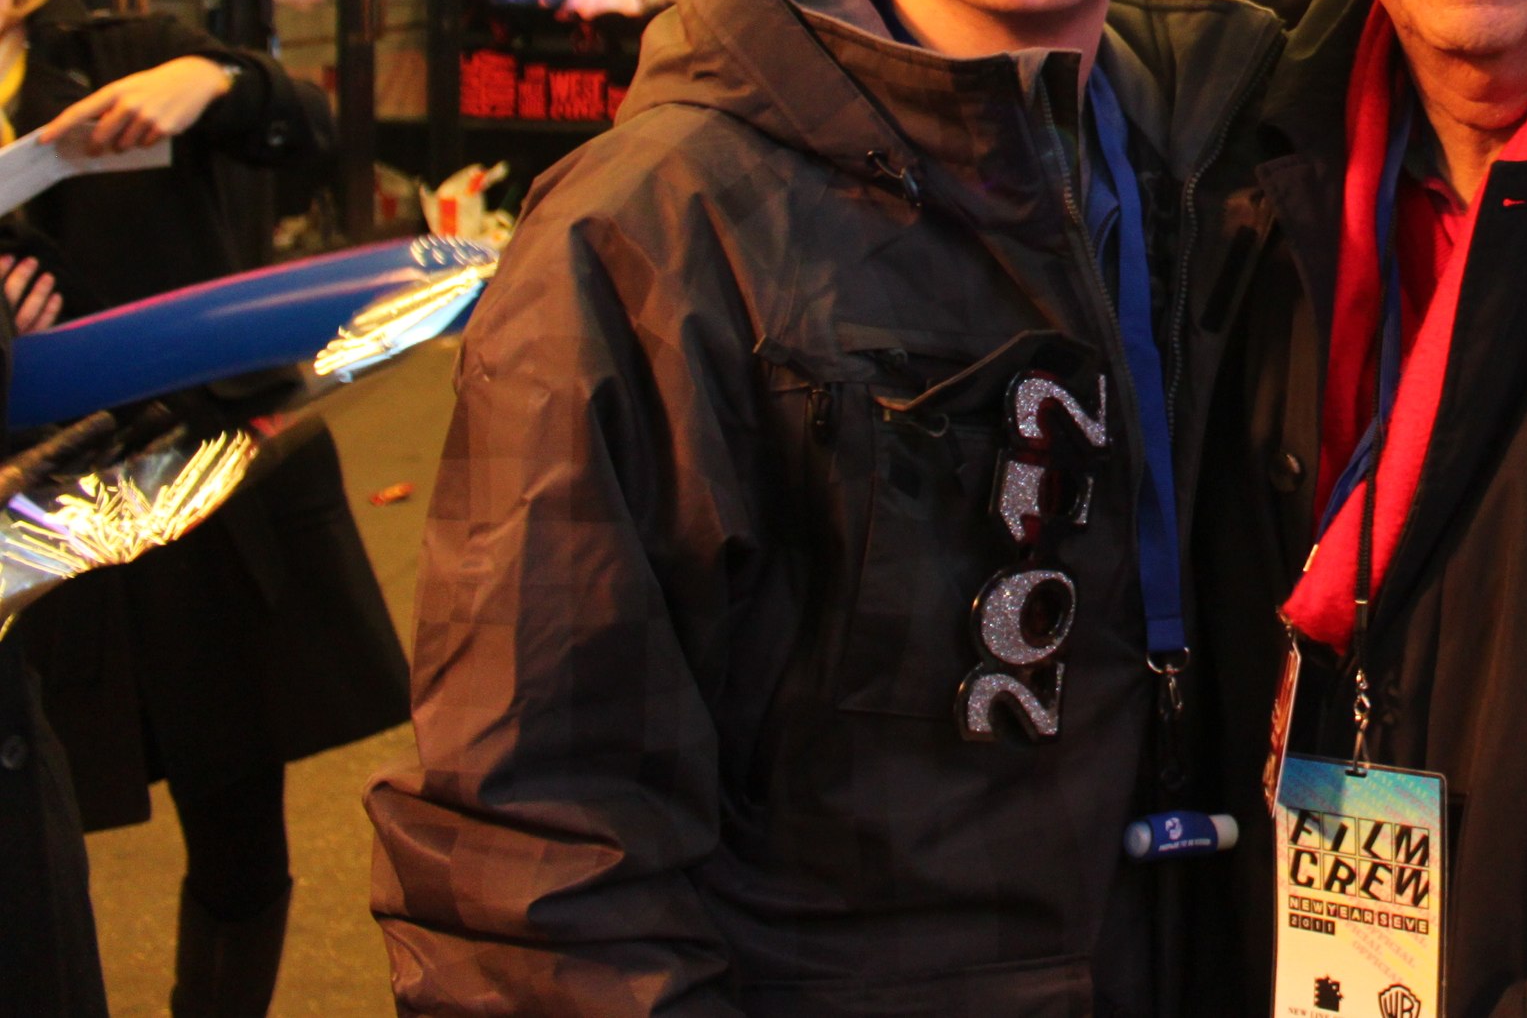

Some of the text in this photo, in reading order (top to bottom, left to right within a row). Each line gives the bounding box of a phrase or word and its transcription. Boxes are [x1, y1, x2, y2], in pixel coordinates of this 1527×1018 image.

[1288, 809, 1430, 868] FILM
[1288, 848, 1430, 908] CREW
[1288, 912, 1335, 935] 2011
